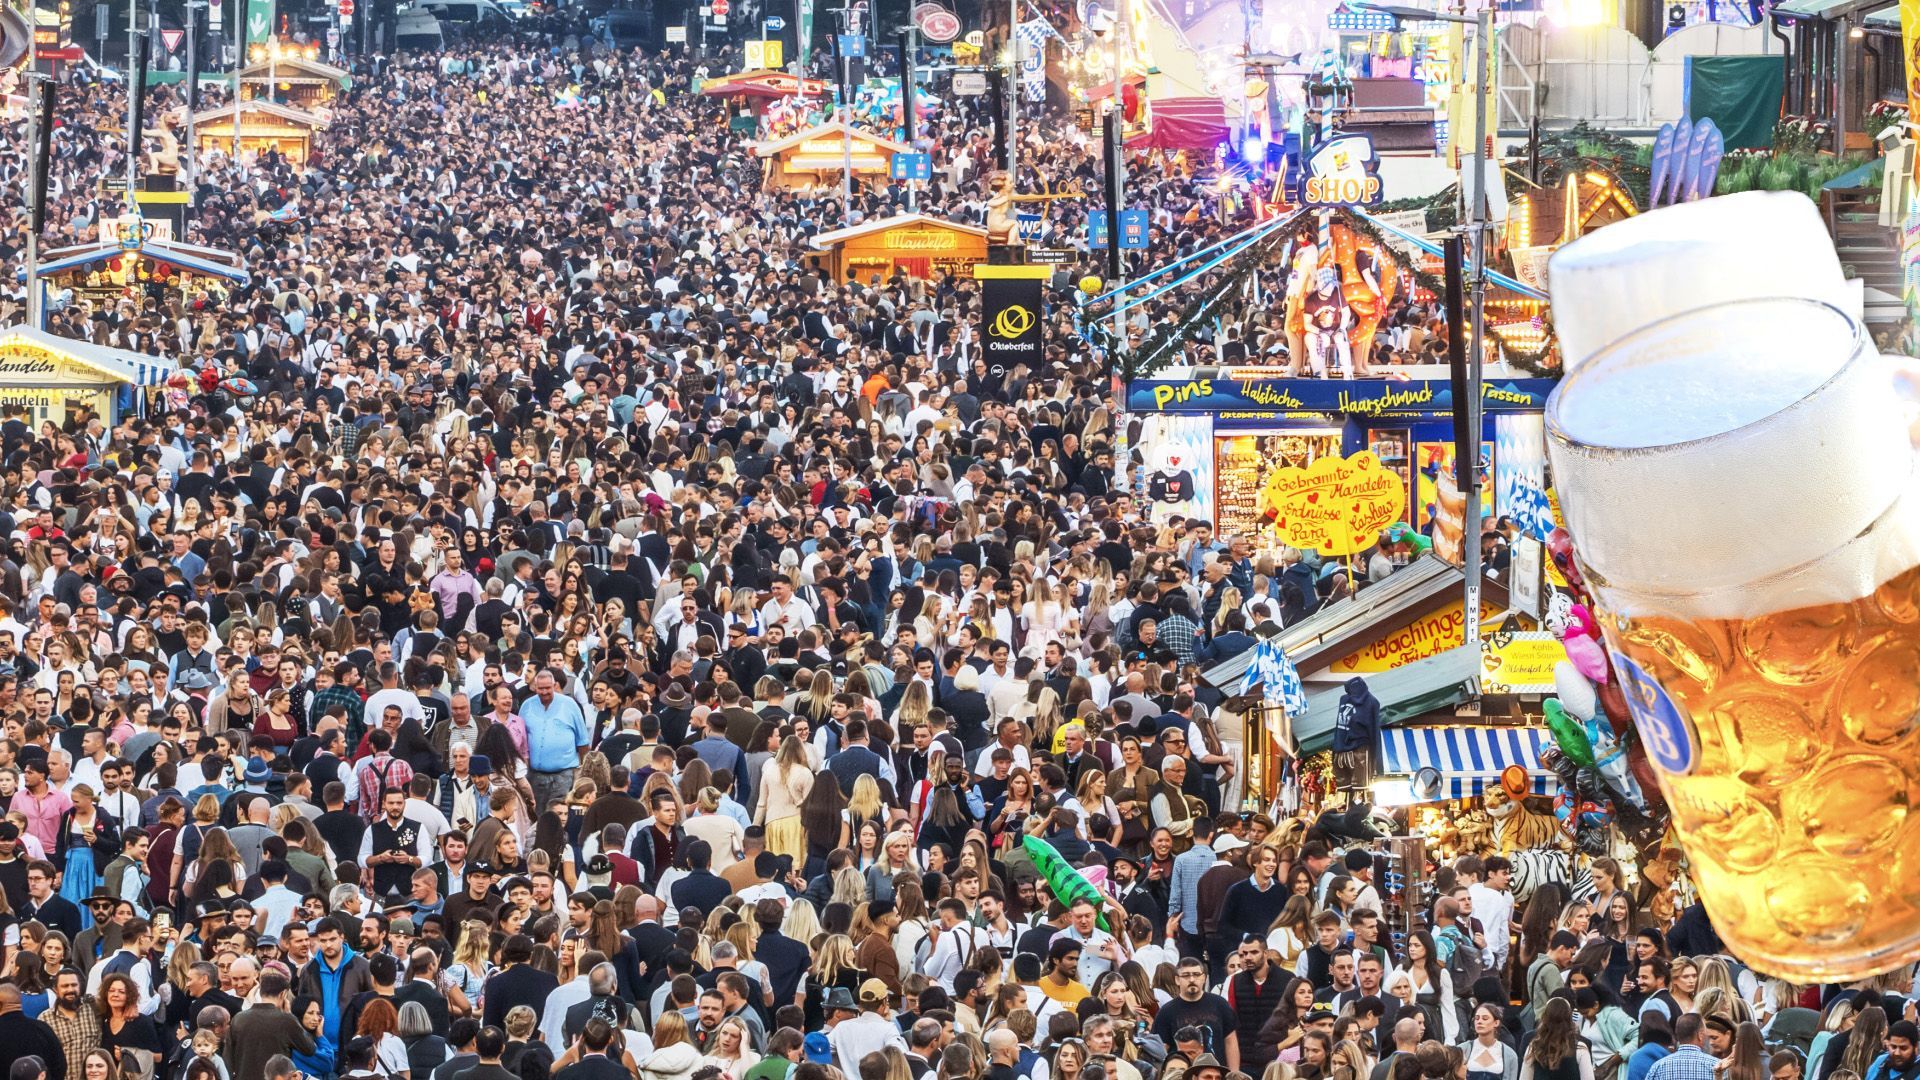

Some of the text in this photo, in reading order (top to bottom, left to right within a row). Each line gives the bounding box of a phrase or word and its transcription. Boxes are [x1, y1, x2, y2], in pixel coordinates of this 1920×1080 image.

[767, 18, 780, 28] WC
[1305, 176, 1380, 203] SHOP
[1019, 220, 1041, 234] WC
[989, 341, 1034, 352] Oktoberfest
[0, 359, 55, 374] andeln
[0, 395, 49, 406] andeln
[1154, 378, 1532, 414] Pins Halstücher Haarschmuck Tassen
[1277, 467, 1350, 492] Gebrannte
[1330, 475, 1392, 499] Mandeln
[1284, 500, 1394, 532] Erdnüsse Cashew
[1290, 523, 1328, 542] Para
